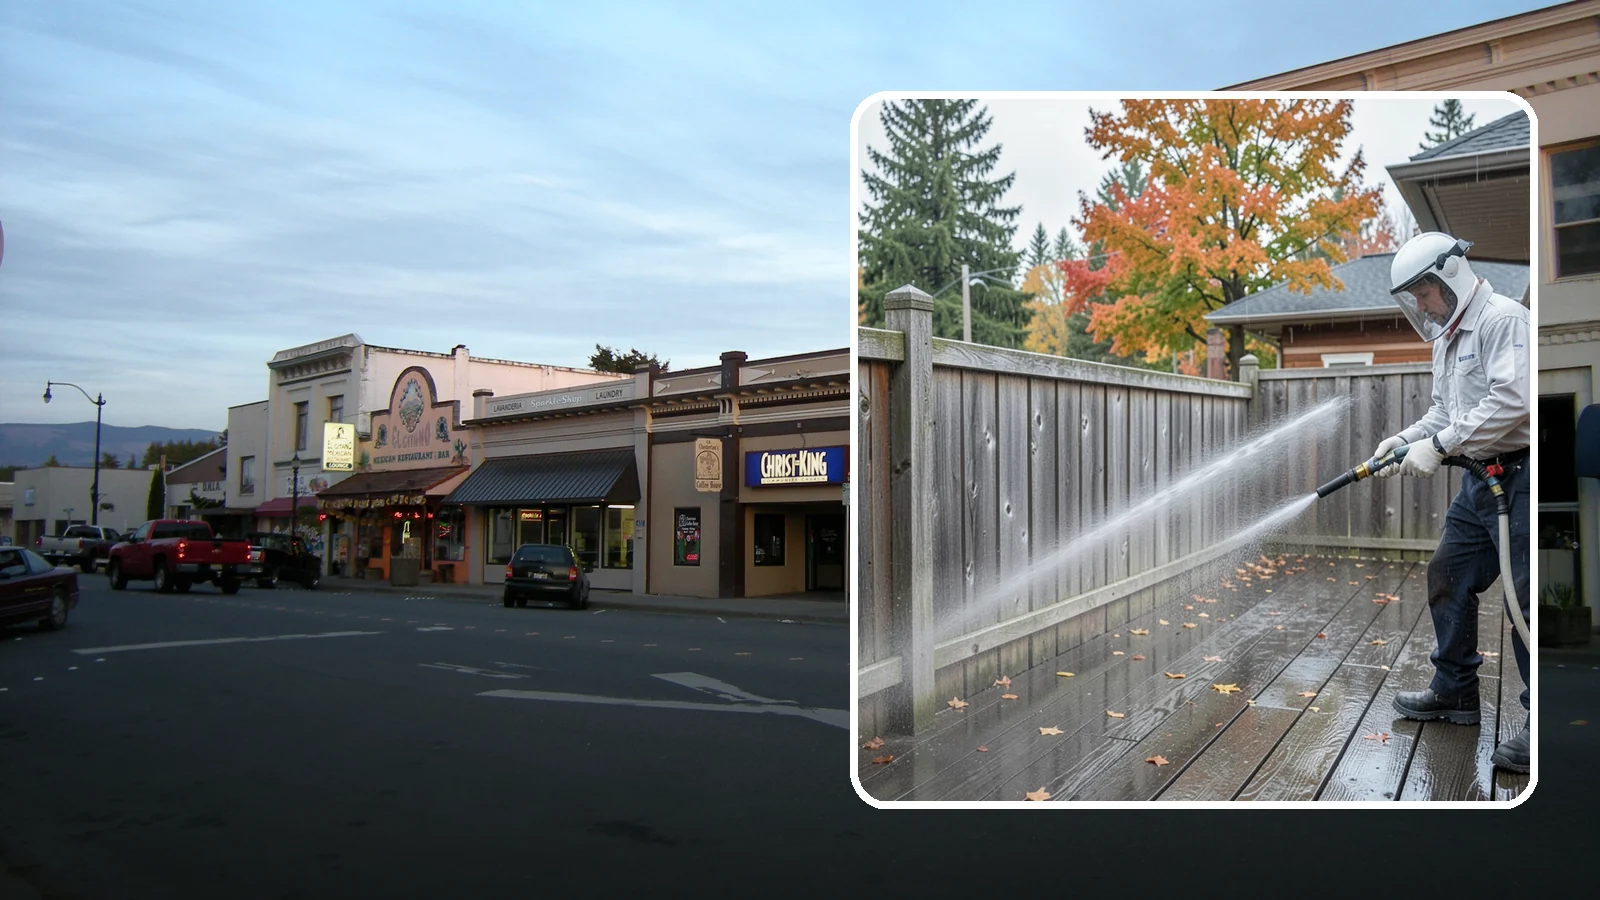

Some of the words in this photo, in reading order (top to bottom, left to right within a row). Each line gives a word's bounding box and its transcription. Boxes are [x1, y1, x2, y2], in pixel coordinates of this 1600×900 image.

[493, 402, 523, 413] LAVANDERIA
[531, 397, 561, 409] Sparkle
[561, 394, 583, 406] Shop
[595, 389, 624, 400] LAUNDRY
[373, 454, 396, 464] MEXICAN
[397, 451, 434, 463] RESTAURANT
[437, 450, 450, 459] BAR
[760, 452, 797, 478] CHRIST
[798, 450, 828, 476] KING
